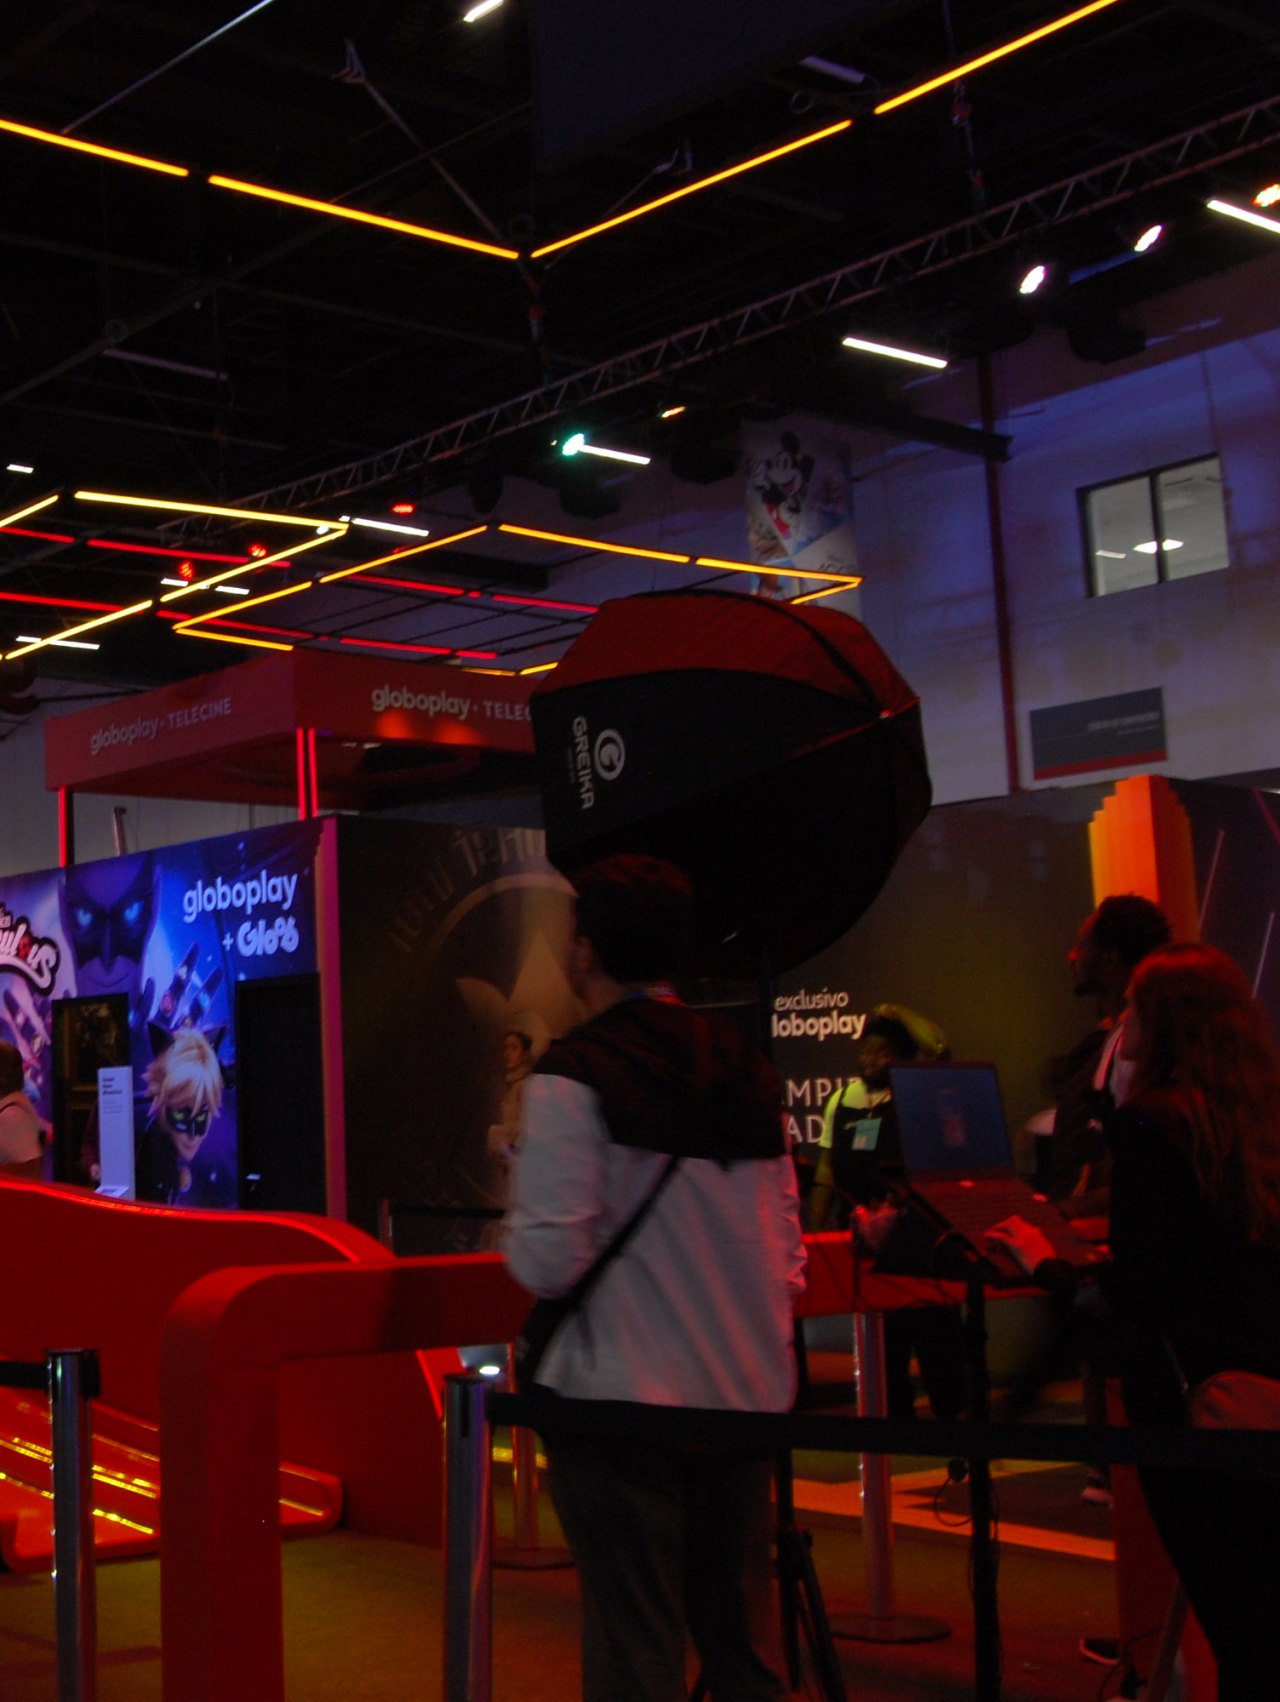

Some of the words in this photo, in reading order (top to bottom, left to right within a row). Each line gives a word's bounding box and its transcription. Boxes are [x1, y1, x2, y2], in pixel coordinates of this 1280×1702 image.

[371, 683, 470, 720] globoplay
[90, 717, 159, 755] globoplay
[167, 697, 232, 729] TELECINE
[572, 715, 595, 810] GREIKA
[183, 868, 298, 924] globoplay
[774, 986, 849, 1012] exclusivo
[771, 1009, 867, 1042] loboplay
